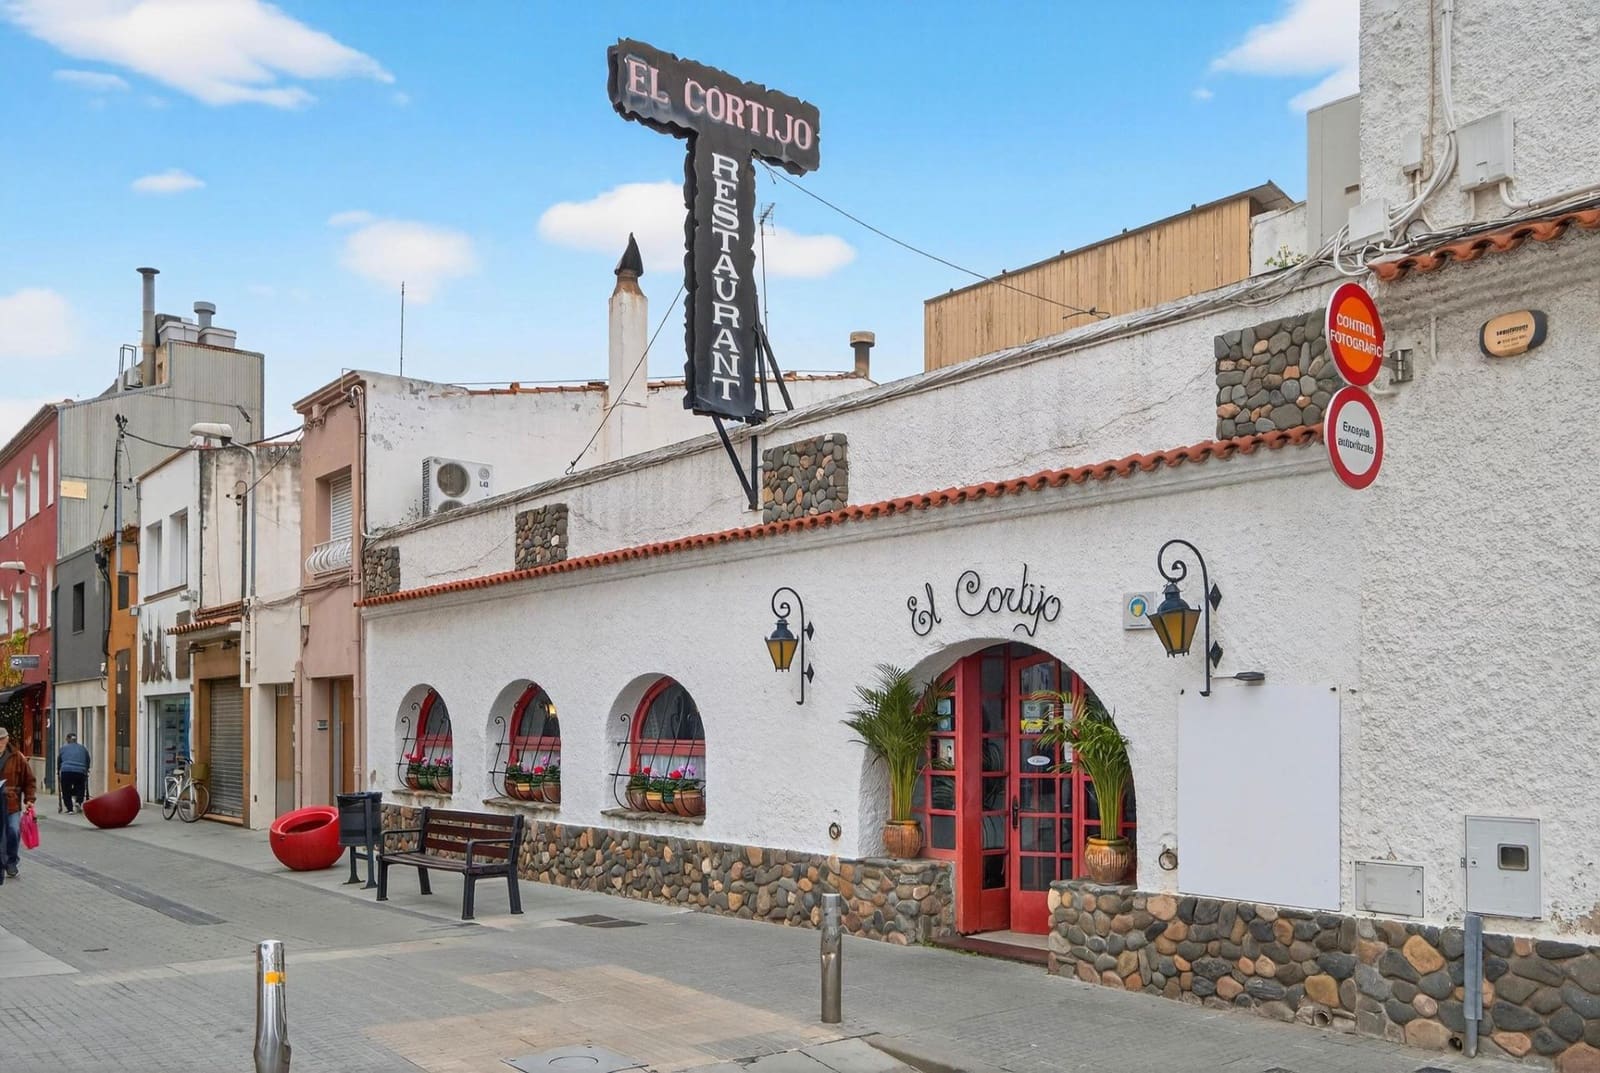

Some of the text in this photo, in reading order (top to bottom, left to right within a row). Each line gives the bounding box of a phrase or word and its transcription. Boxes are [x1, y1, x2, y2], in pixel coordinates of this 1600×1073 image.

[626, 58, 812, 150] EL CORTIJO
[711, 152, 741, 401] RESTAURANT
[1336, 313, 1376, 338] CONTROL
[907, 563, 1061, 637] El Cortijo
